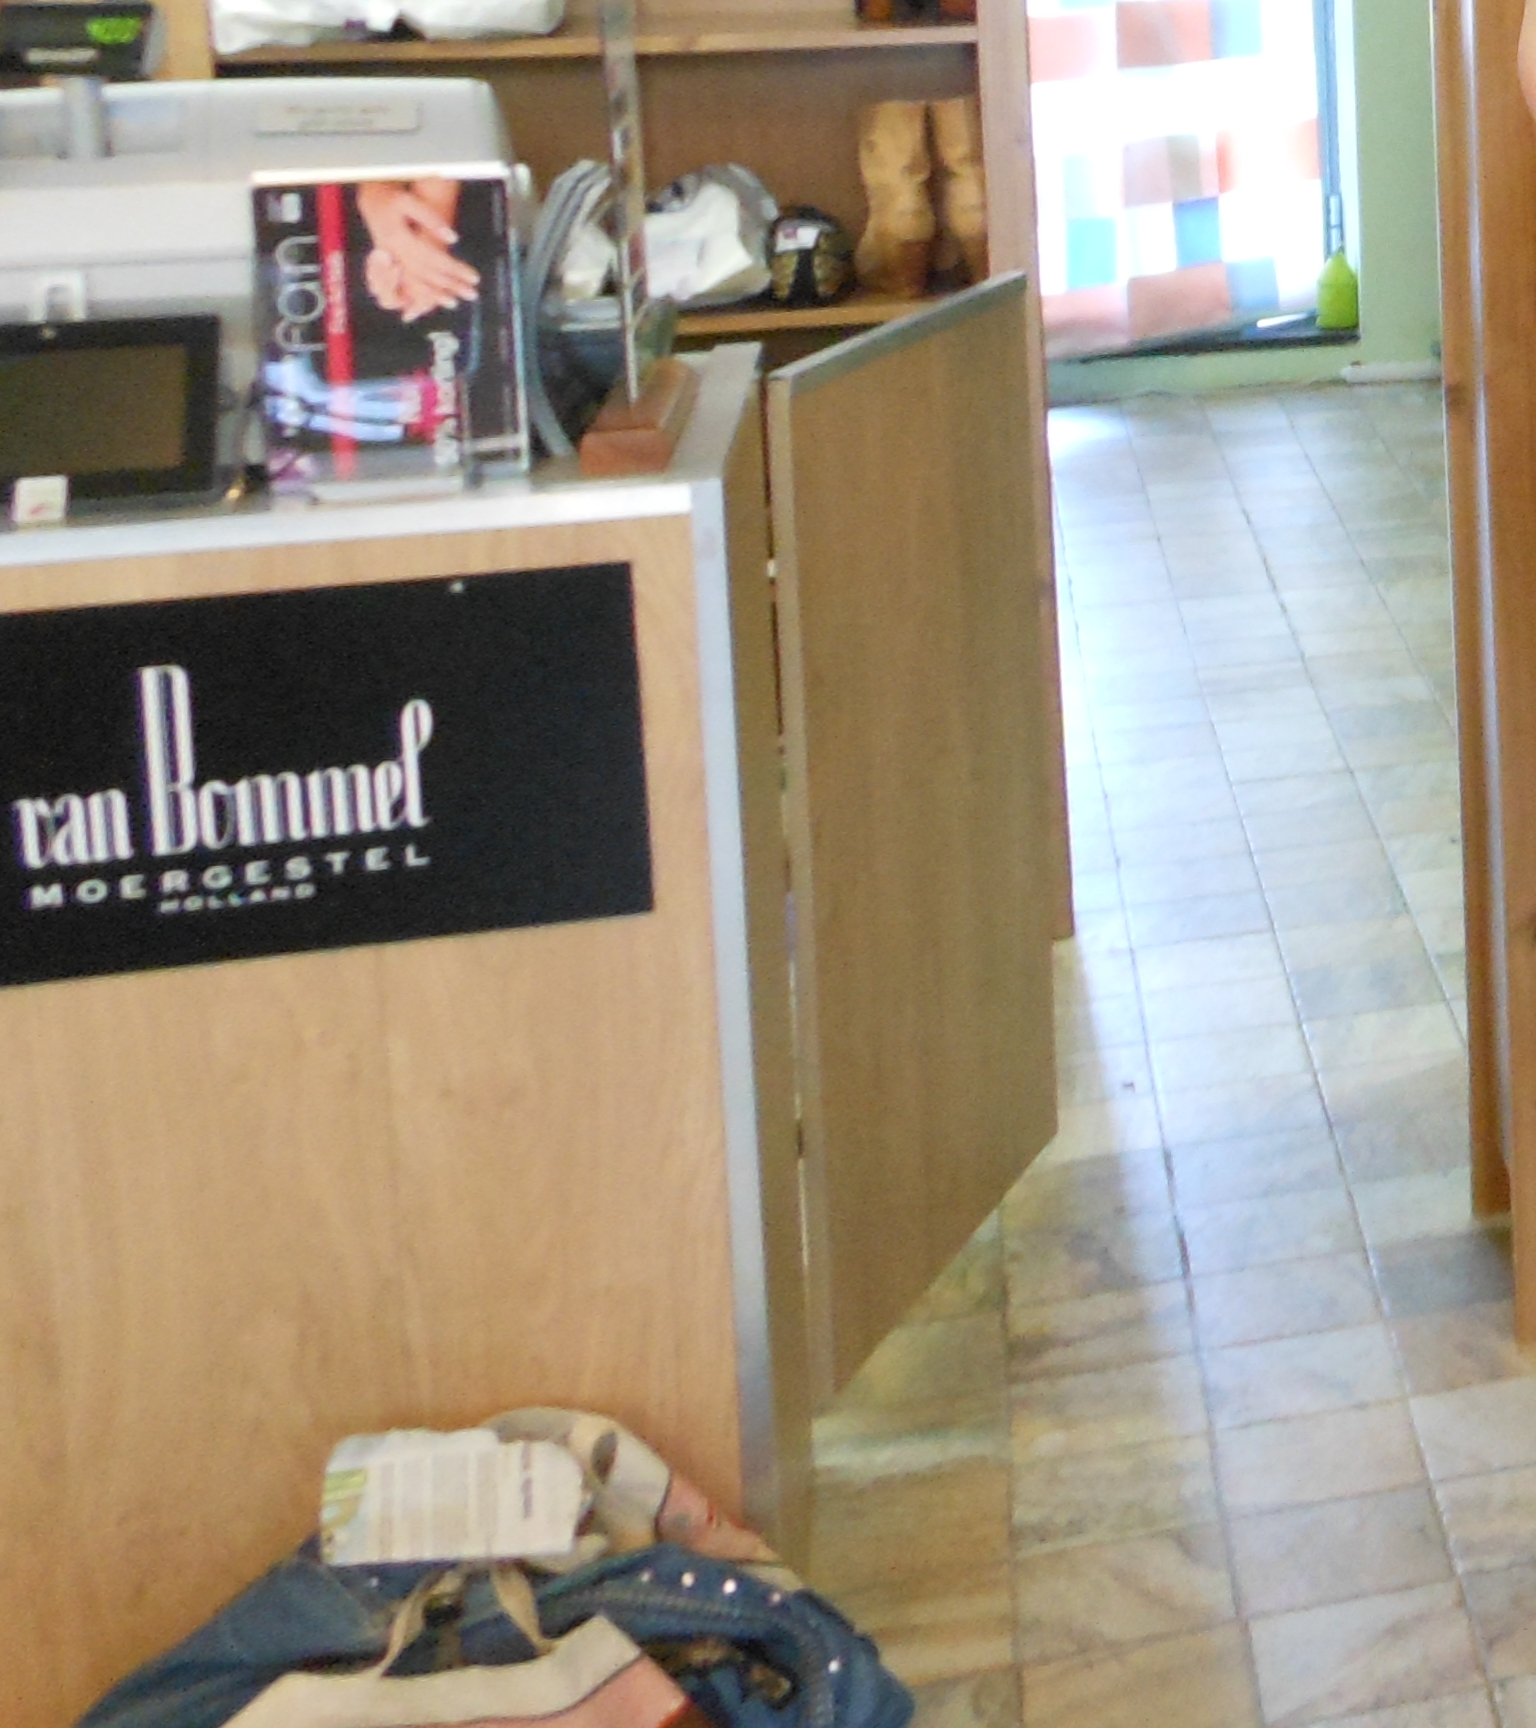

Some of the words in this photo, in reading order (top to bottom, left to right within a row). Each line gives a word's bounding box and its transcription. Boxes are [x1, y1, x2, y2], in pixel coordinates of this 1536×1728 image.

[13, 788, 134, 870] van
[140, 664, 433, 857] Bommel
[29, 844, 431, 910] MOERGESTEL
